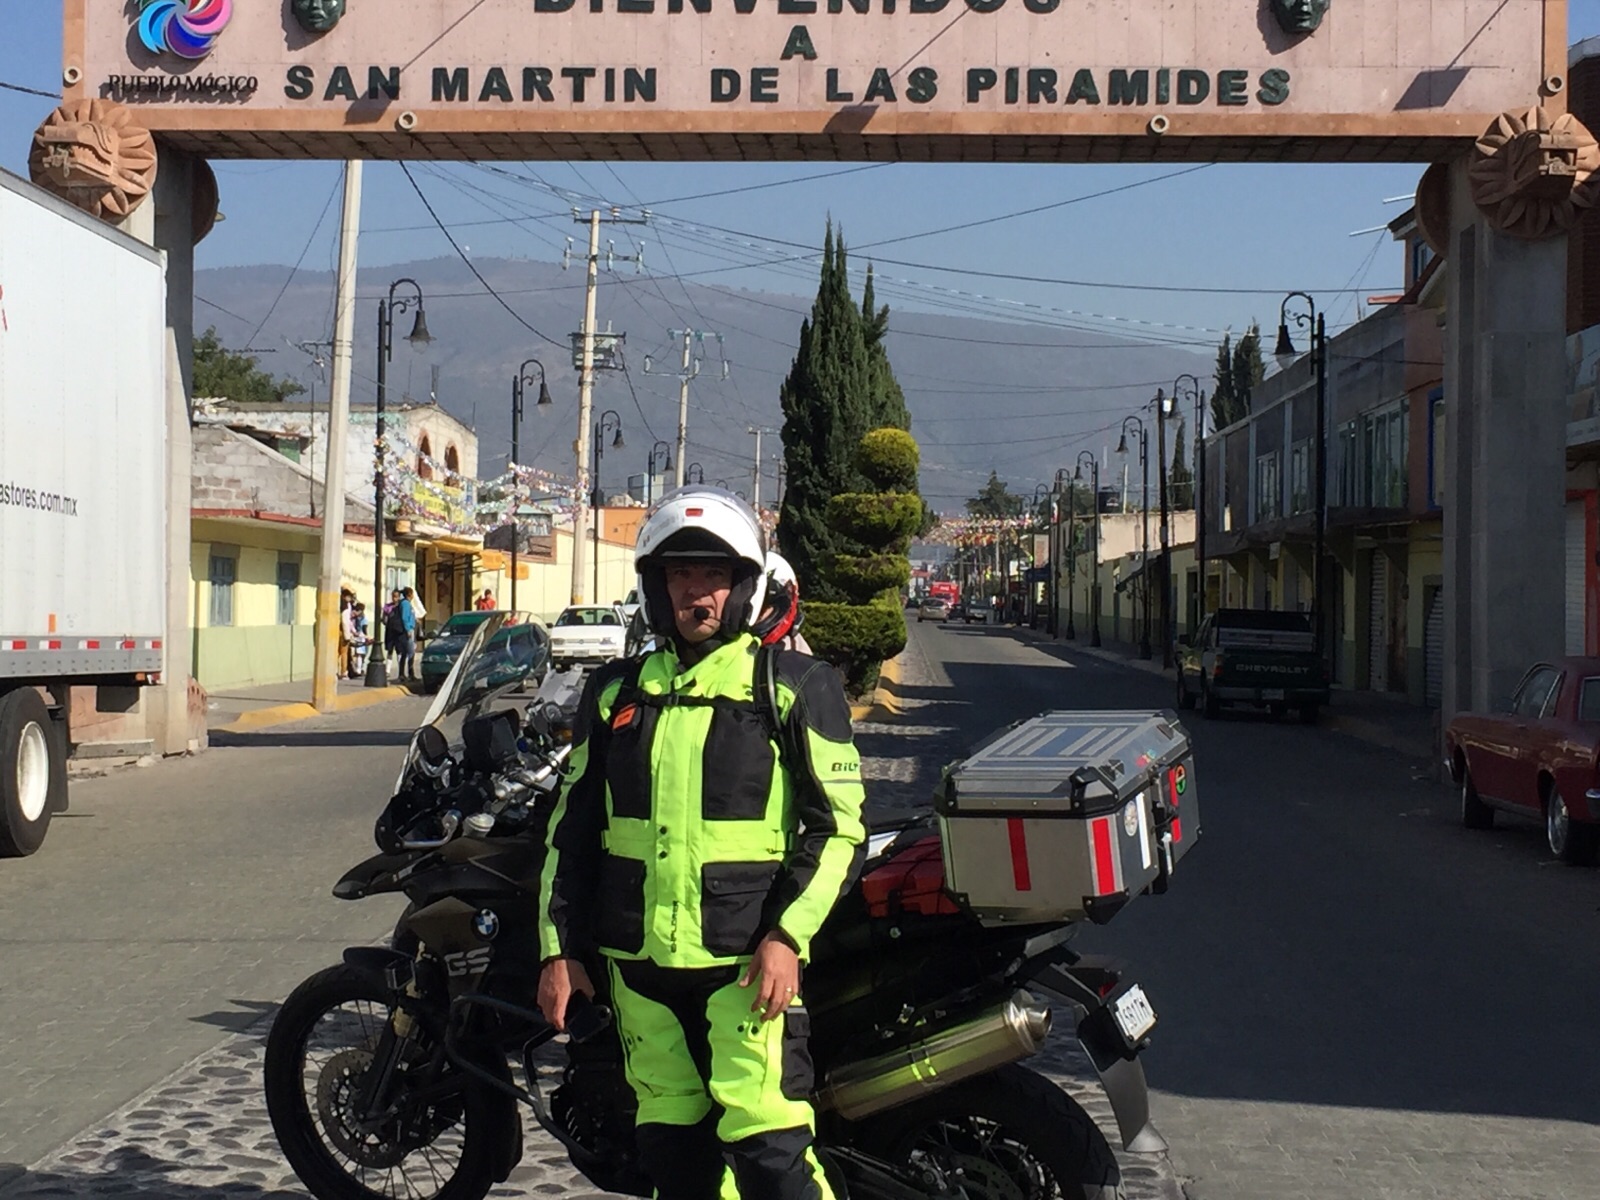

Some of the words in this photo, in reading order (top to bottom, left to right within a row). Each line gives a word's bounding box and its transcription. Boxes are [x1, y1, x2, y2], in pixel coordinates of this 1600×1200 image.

[780, 25, 818, 61] A
[108, 74, 181, 94] PUEBLO
[284, 65, 400, 101] SAN
[431, 67, 657, 103] MARTIN
[710, 68, 779, 104] DE
[826, 67, 938, 104] LAS
[966, 67, 1291, 107] PIRAMIDES
[1235, 663, 1310, 675] CHEVROLET
[444, 946, 491, 977] GS
